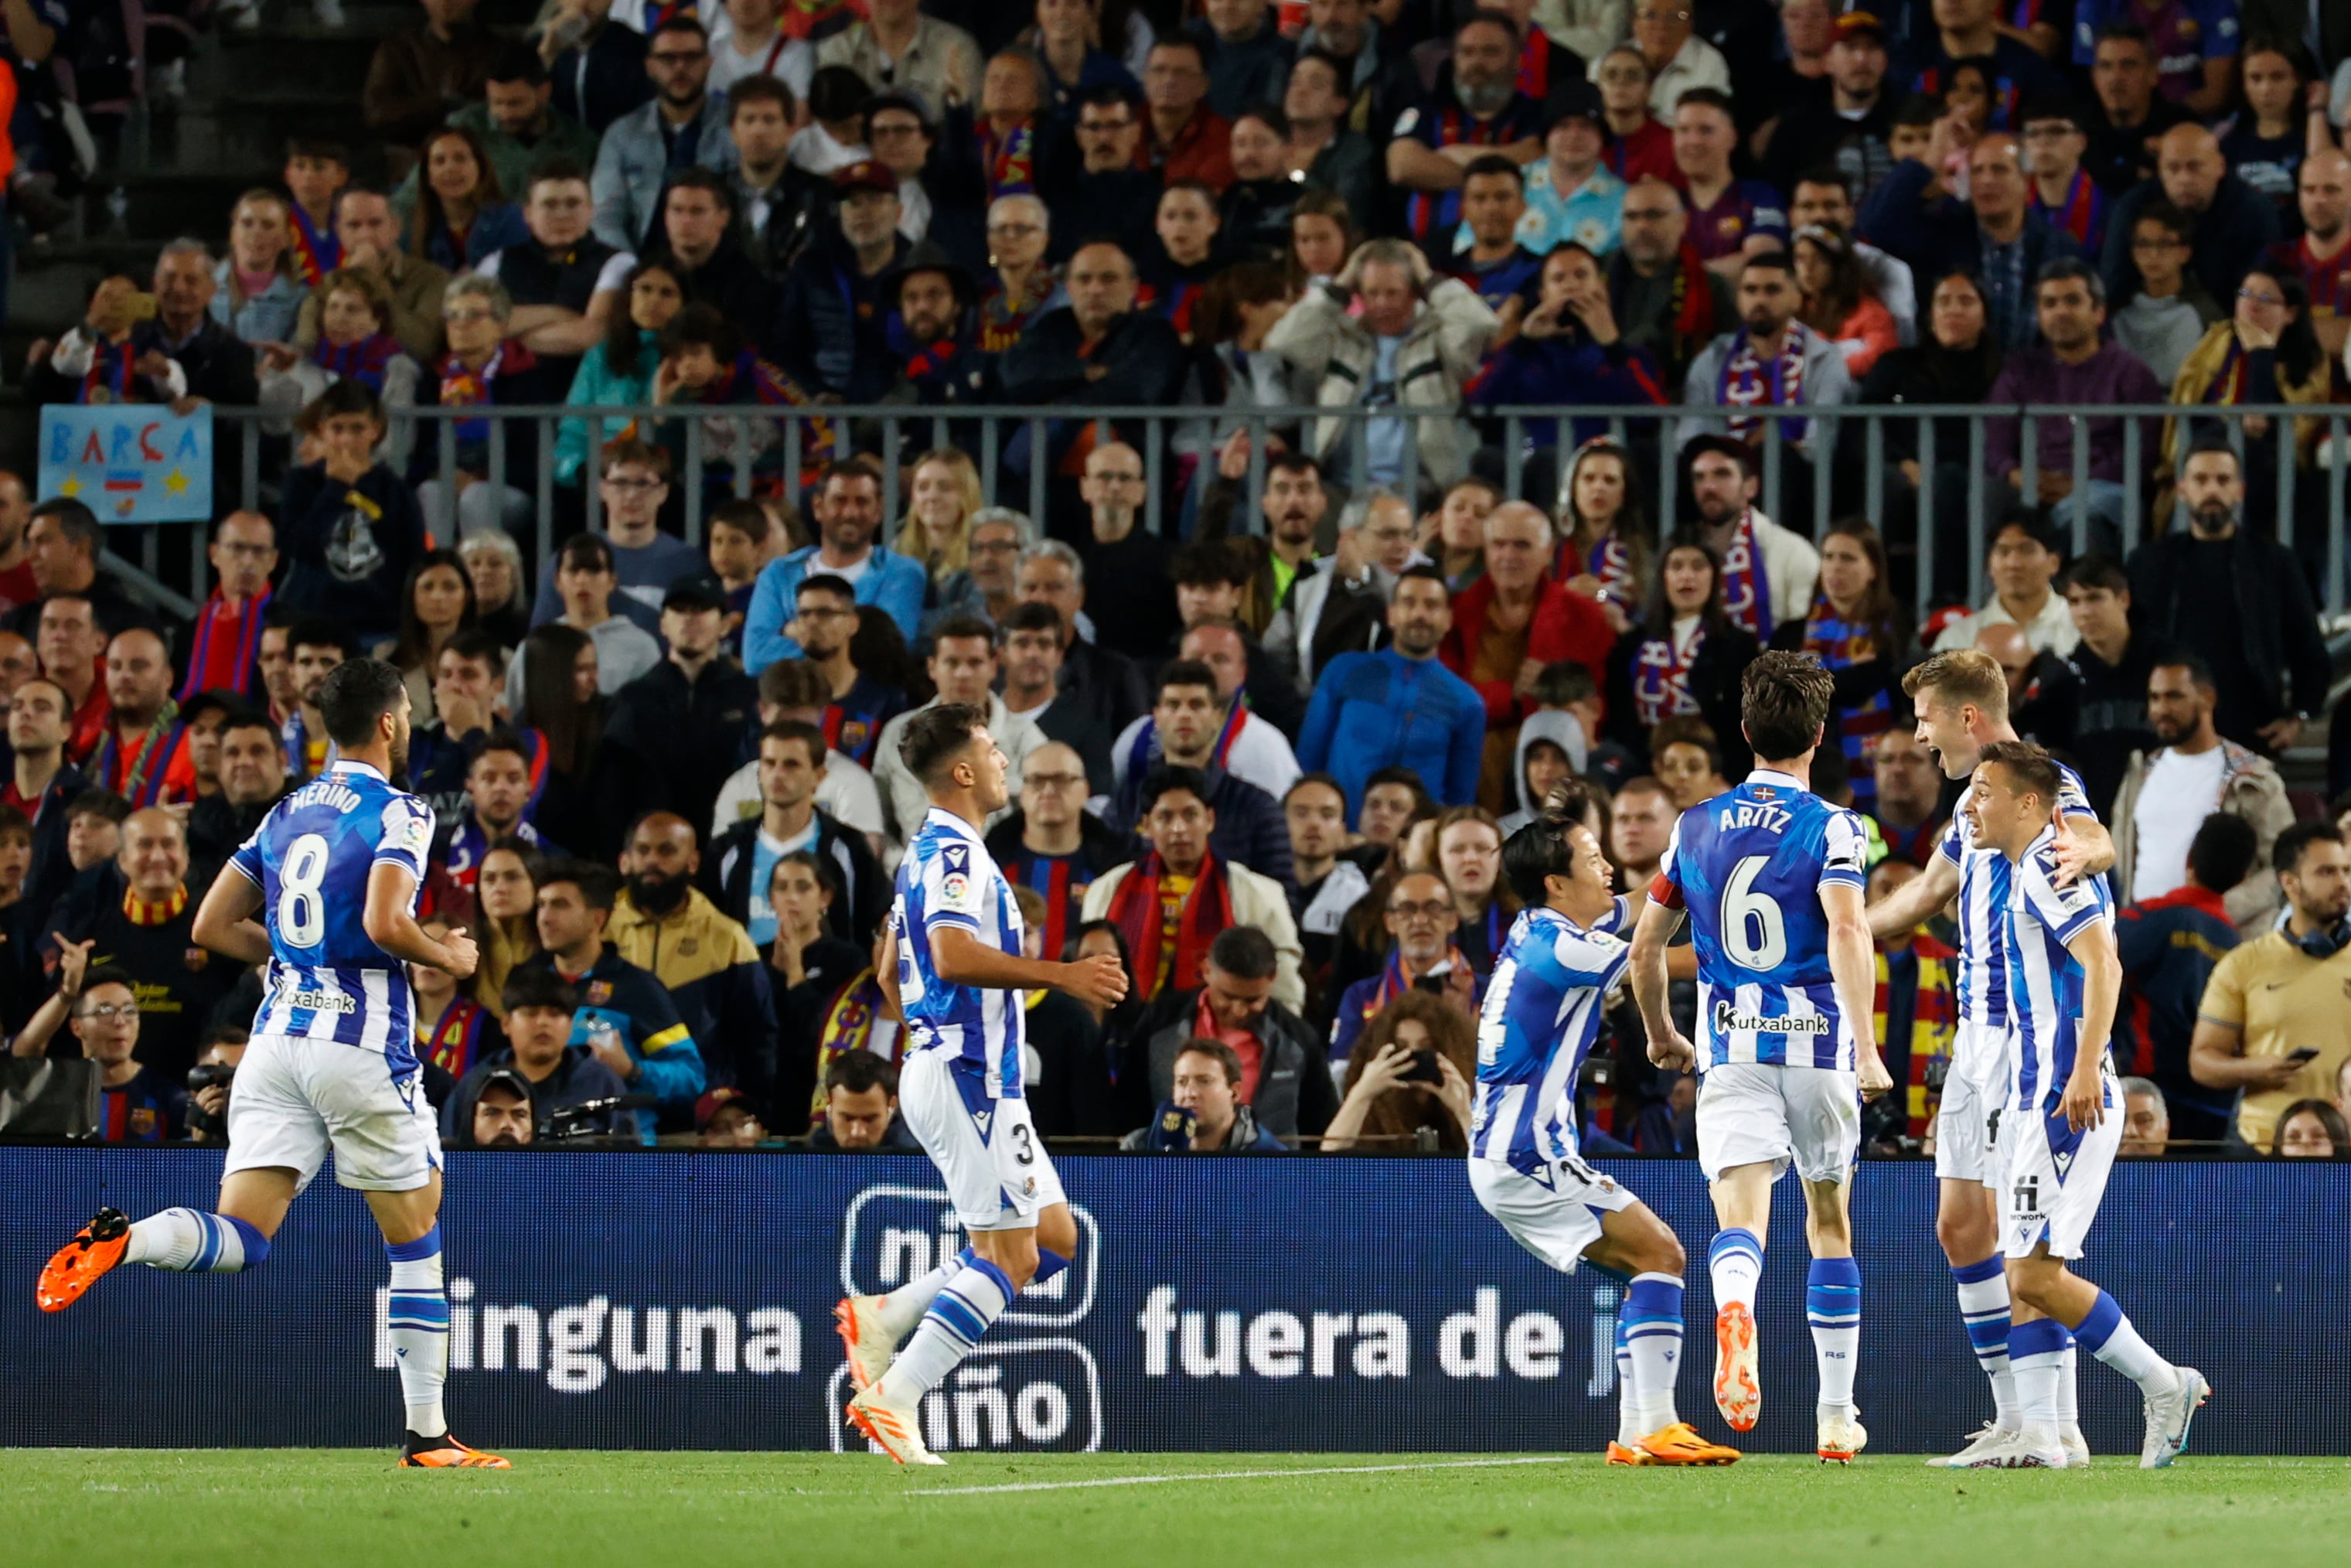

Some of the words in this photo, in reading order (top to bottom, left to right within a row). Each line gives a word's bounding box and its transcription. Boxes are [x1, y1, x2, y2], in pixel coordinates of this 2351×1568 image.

[50, 421, 199, 465] BARÇA
[290, 783, 362, 814] MERINO
[1720, 806, 1792, 834] ARITZ
[278, 833, 329, 949] 8
[1720, 855, 1787, 973] 6
[1717, 1002, 1829, 1034] Kutxabank
[1010, 1123, 1034, 1167] 3
[1138, 1284, 1409, 1378] fuera
[1439, 1285, 1564, 1379] de
[1825, 1351, 1846, 1359] RS
